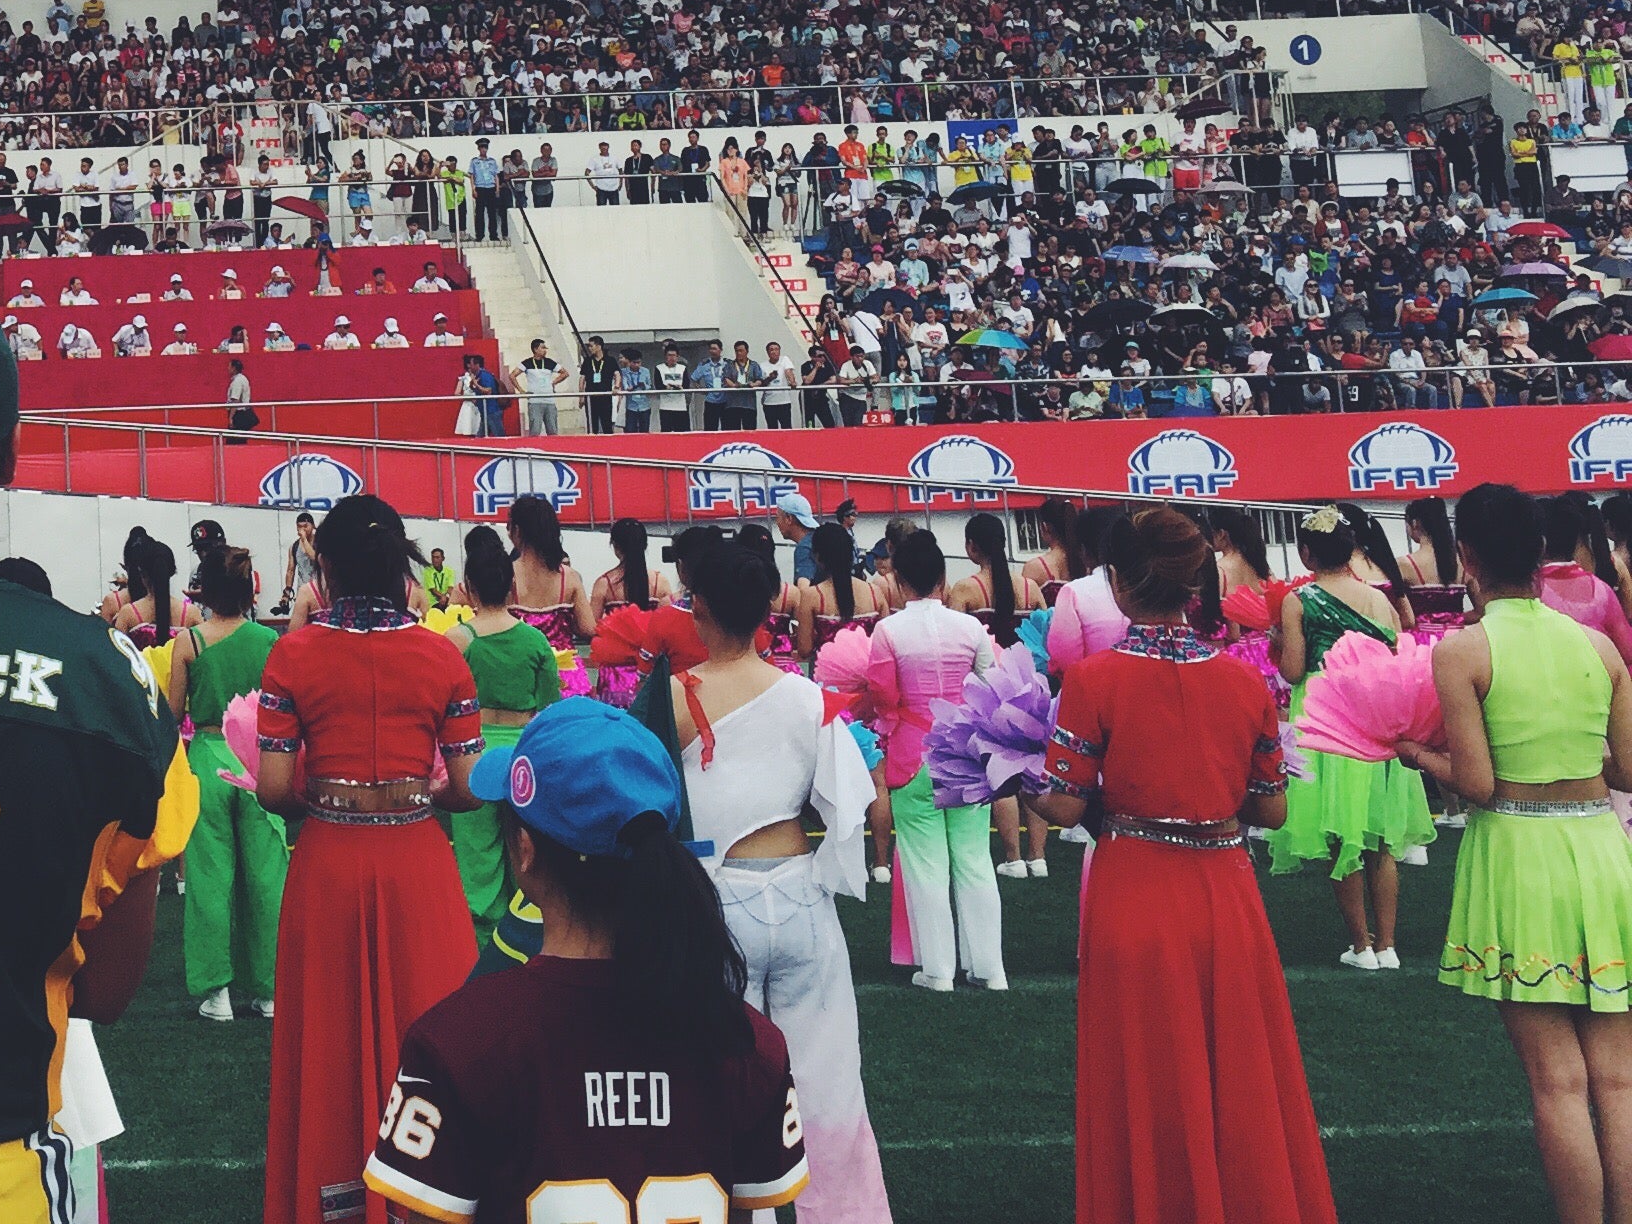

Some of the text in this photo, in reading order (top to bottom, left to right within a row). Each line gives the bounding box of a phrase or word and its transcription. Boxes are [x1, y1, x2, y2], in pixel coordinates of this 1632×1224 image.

[1298, 40, 1309, 60] 1
[1130, 473, 1236, 494] IFAF
[1351, 465, 1457, 489] IFAF
[692, 485, 797, 508] IFAF
[584, 1072, 670, 1127] REED
